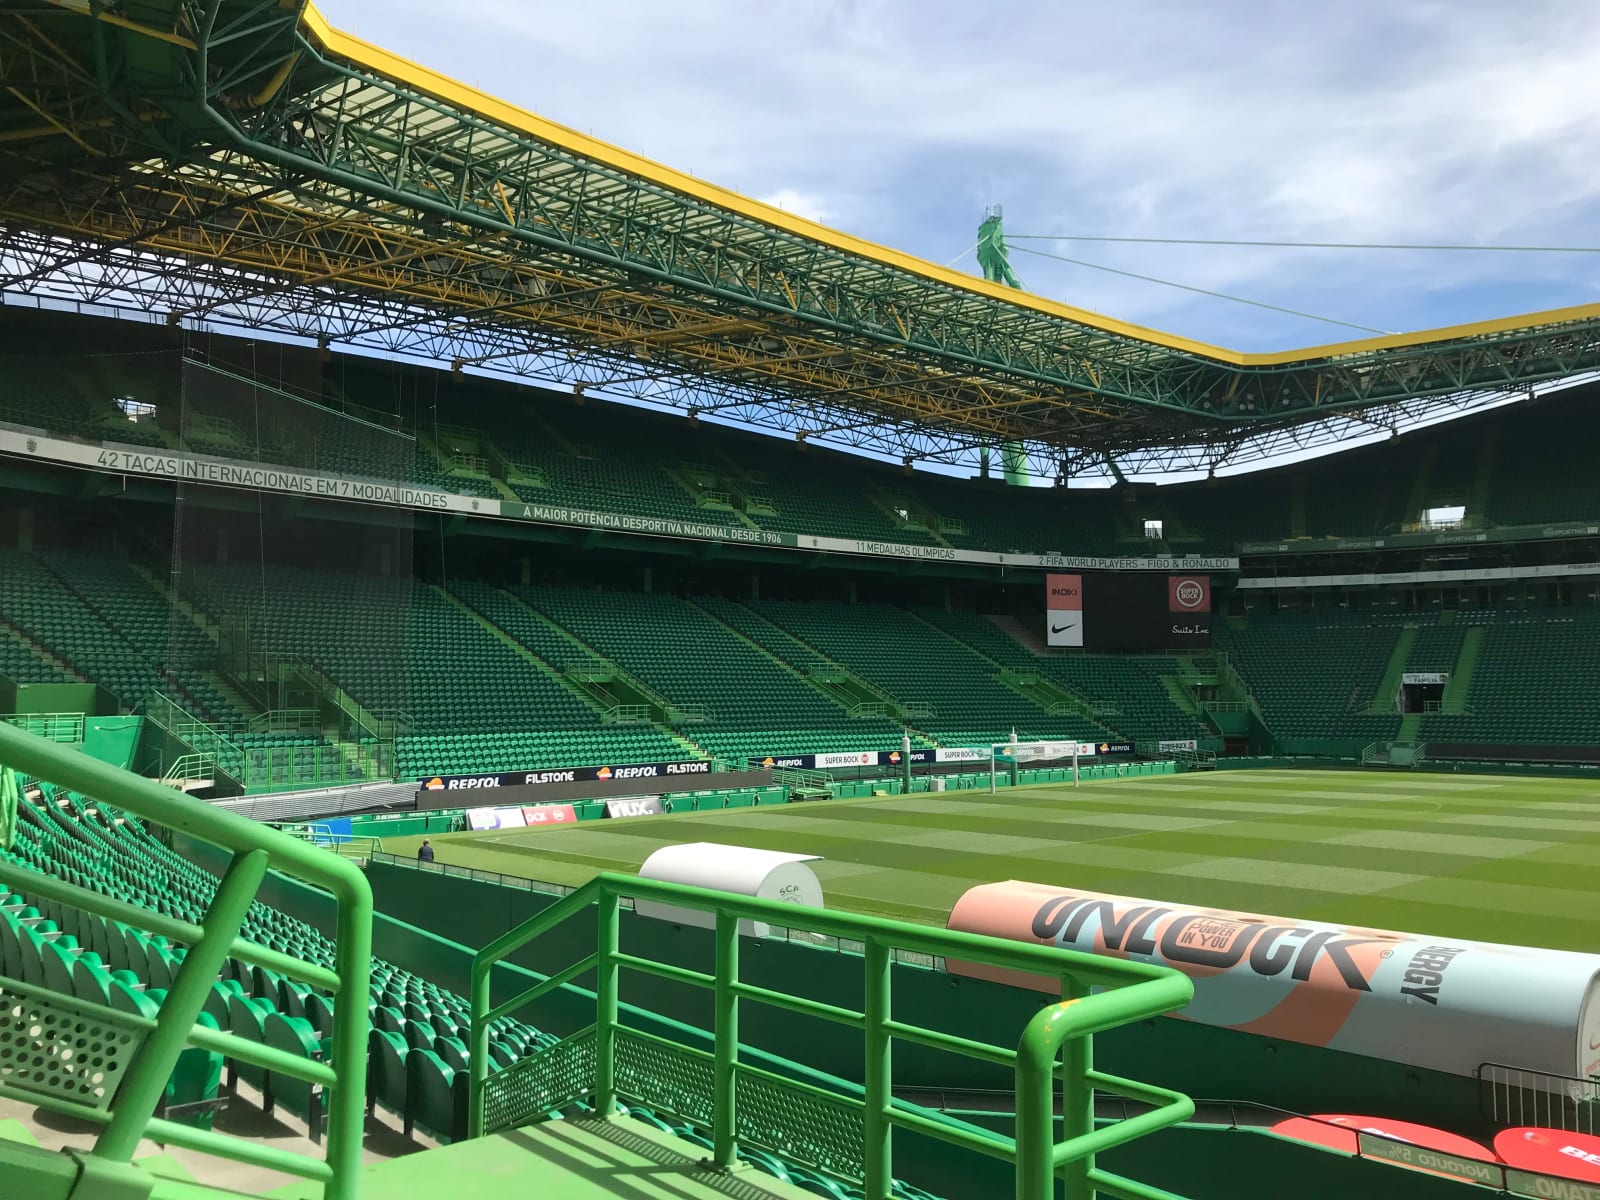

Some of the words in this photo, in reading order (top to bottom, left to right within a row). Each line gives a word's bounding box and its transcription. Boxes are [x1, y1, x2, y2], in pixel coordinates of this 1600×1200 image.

[97, 451, 119, 468] 42
[122, 453, 177, 475] TAÇAS
[181, 461, 313, 493] INTERNACIONAIS
[316, 479, 338, 495] EM
[341, 481, 349, 496] 7
[352, 483, 448, 508] MODALIDADES
[523, 505, 532, 517] A
[534, 507, 568, 521] MAIOR
[623, 517, 682, 534] DESPORTIVA
[684, 524, 729, 539] NACIONAL
[731, 529, 761, 542] DESDE
[762, 532, 782, 544] 1906
[856, 542, 865, 552] 11
[867, 543, 911, 556] MEDALHAS
[1038, 557, 1045, 565] 2
[1046, 557, 1064, 567] FIFA
[1067, 558, 1097, 568] WORLD
[1098, 559, 1138, 569] PLAYERS
[1147, 559, 1169, 568] FIGO
[1172, 559, 1180, 568] &
[1183, 559, 1230, 568] RONALDO
[825, 756, 842, 764] SUPER
[843, 755, 859, 763] BOCK
[944, 751, 961, 759] SUPER
[961, 750, 975, 758] BOCK
[777, 759, 803, 767] REPSOL
[448, 776, 501, 790] REPSOL
[525, 771, 575, 785] FILSTONE
[615, 766, 658, 779] REPSOL
[666, 763, 708, 774] FILSTONE
[779, 885, 800, 897] SCP
[1187, 923, 1236, 937] POWER
[1032, 896, 1397, 993] UNLOCK
[1180, 931, 1196, 944] IN
[1200, 934, 1229, 948] YOU
